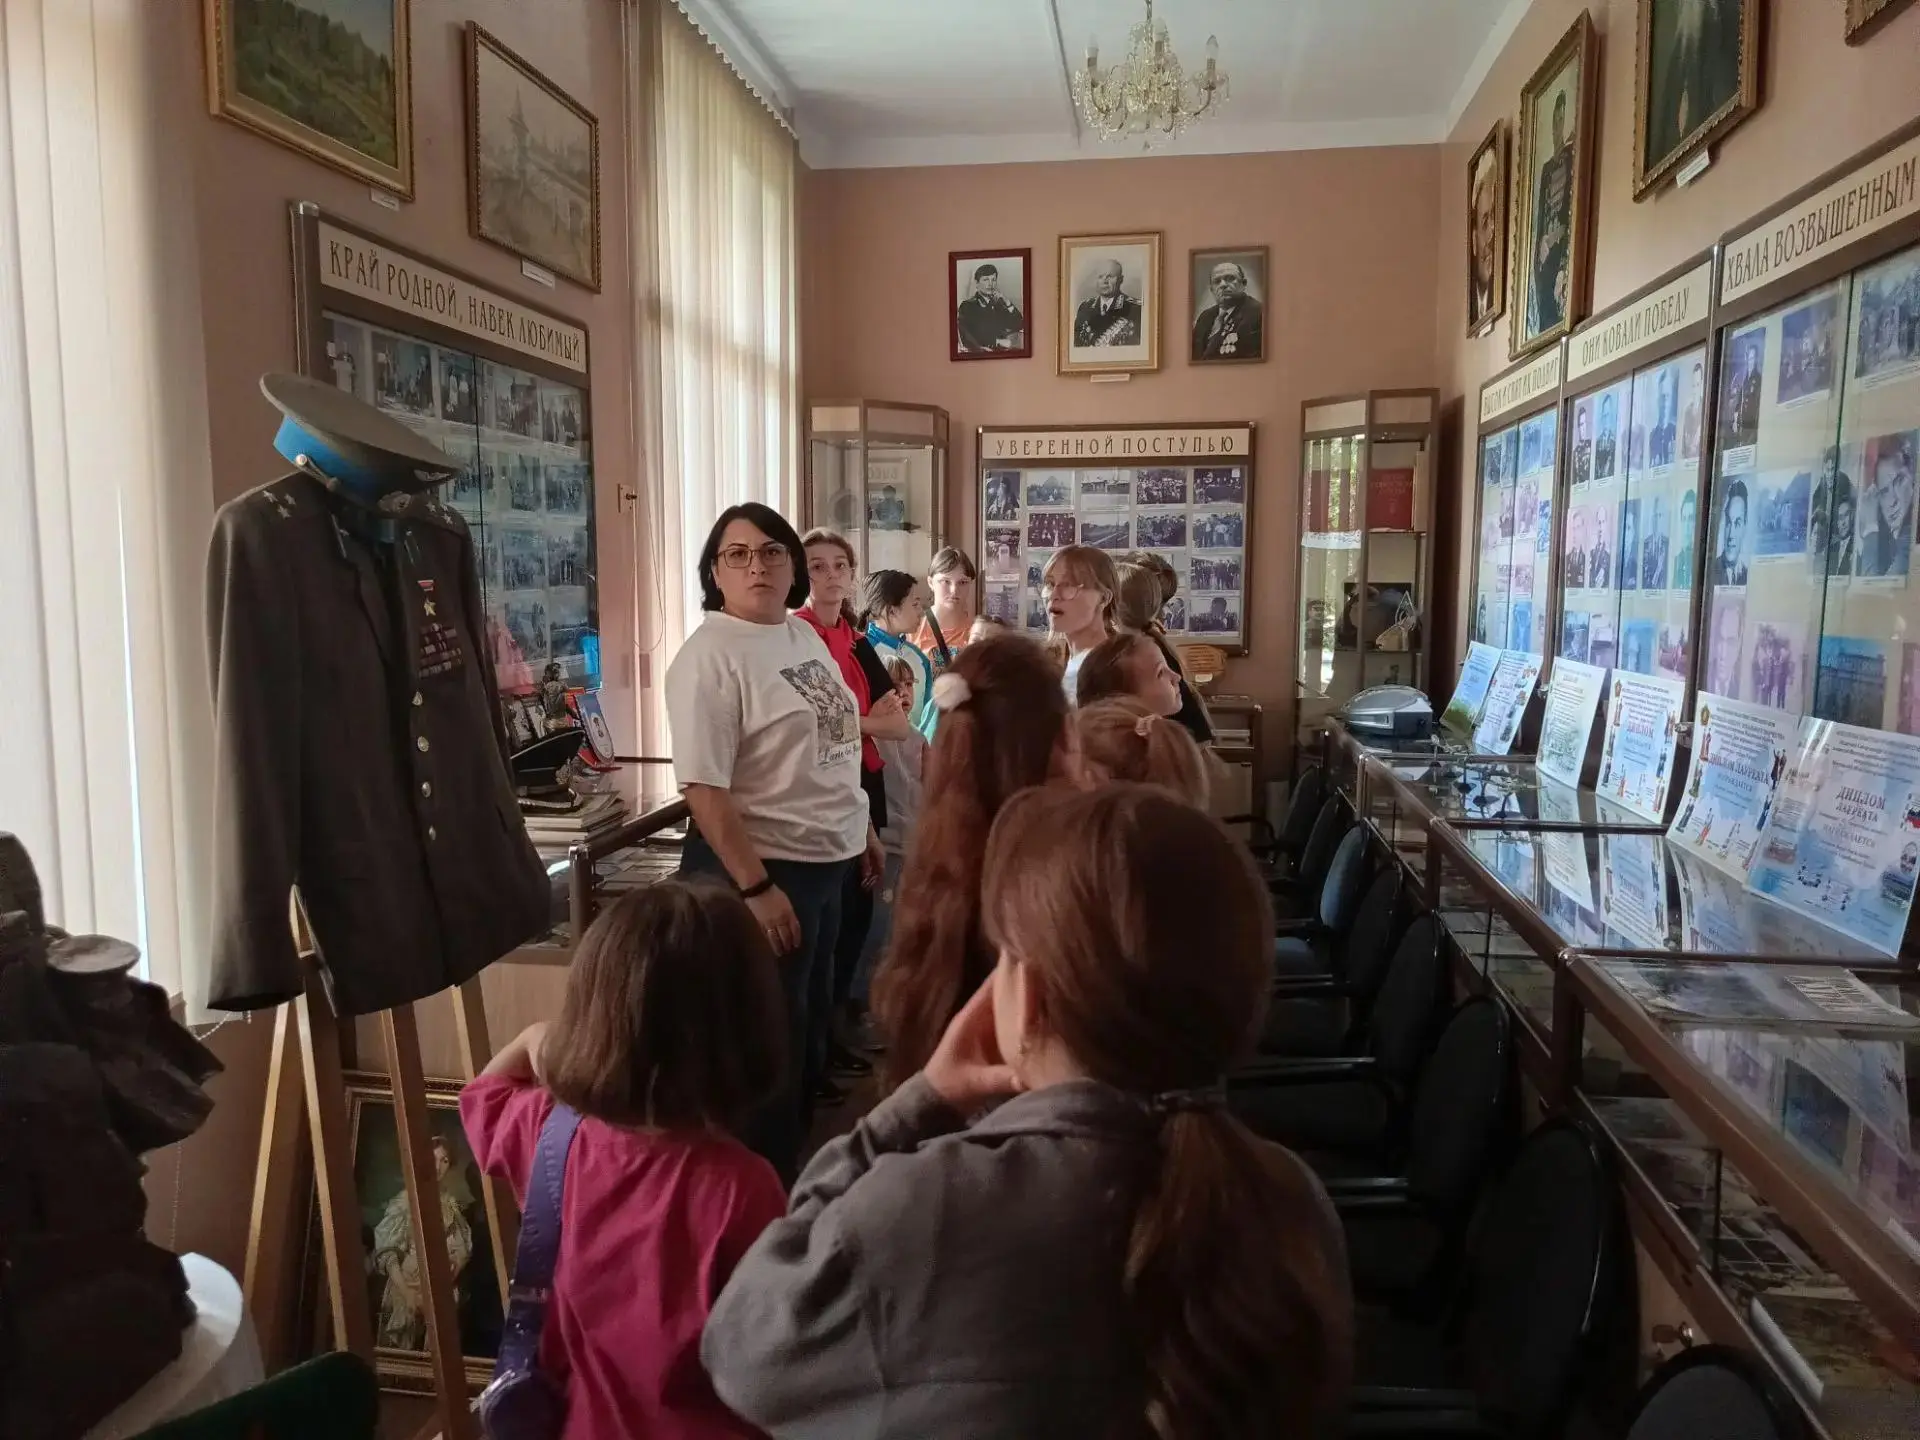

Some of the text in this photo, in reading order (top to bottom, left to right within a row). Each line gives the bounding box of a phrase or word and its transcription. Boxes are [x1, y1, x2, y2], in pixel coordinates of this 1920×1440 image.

[1725, 156, 1917, 292] ХВАЛА ВОЗВЫШЕННЫМ
[329, 240, 580, 363] КРАЙ РОДНОЙ, НАВЕК ЛЮБИМЫЙ
[1582, 287, 1690, 367] ОНИ КОВАЛИ ПОБЕДУ
[996, 434, 1234, 456] УВЕРЕННОЙ ПОСТУПЬЮ
[1836, 785, 1886, 810] ДИПЛОМ
